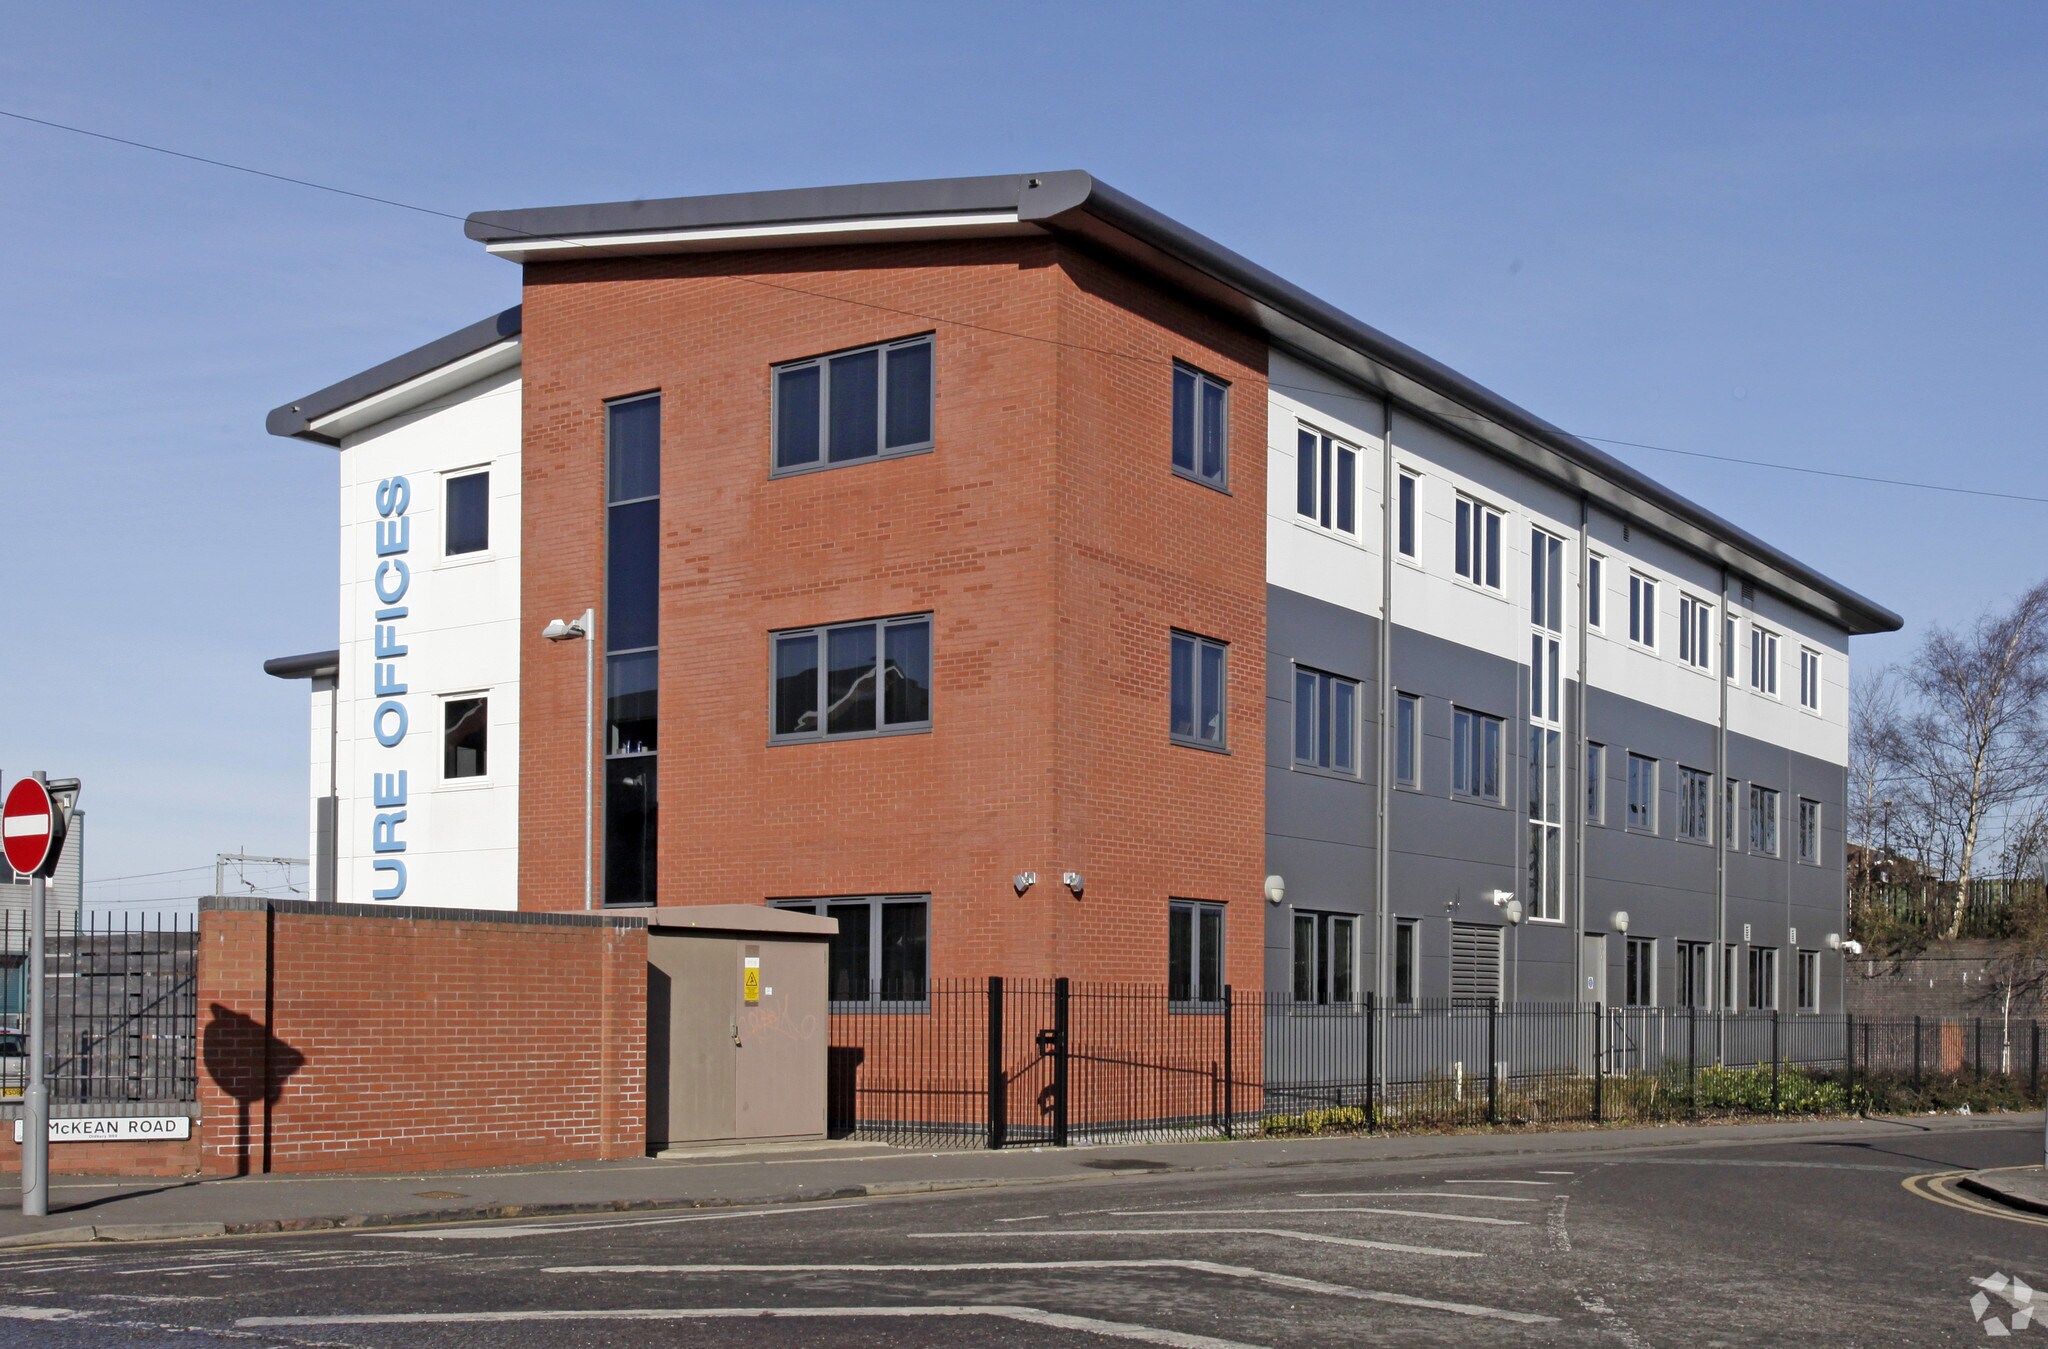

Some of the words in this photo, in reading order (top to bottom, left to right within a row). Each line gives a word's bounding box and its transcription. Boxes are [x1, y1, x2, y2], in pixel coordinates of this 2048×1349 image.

[374, 475, 411, 747] OFFICES
[373, 769, 407, 901] URE
[48, 1121, 119, 1134] McKEAN
[128, 1120, 177, 1133] ROAD
